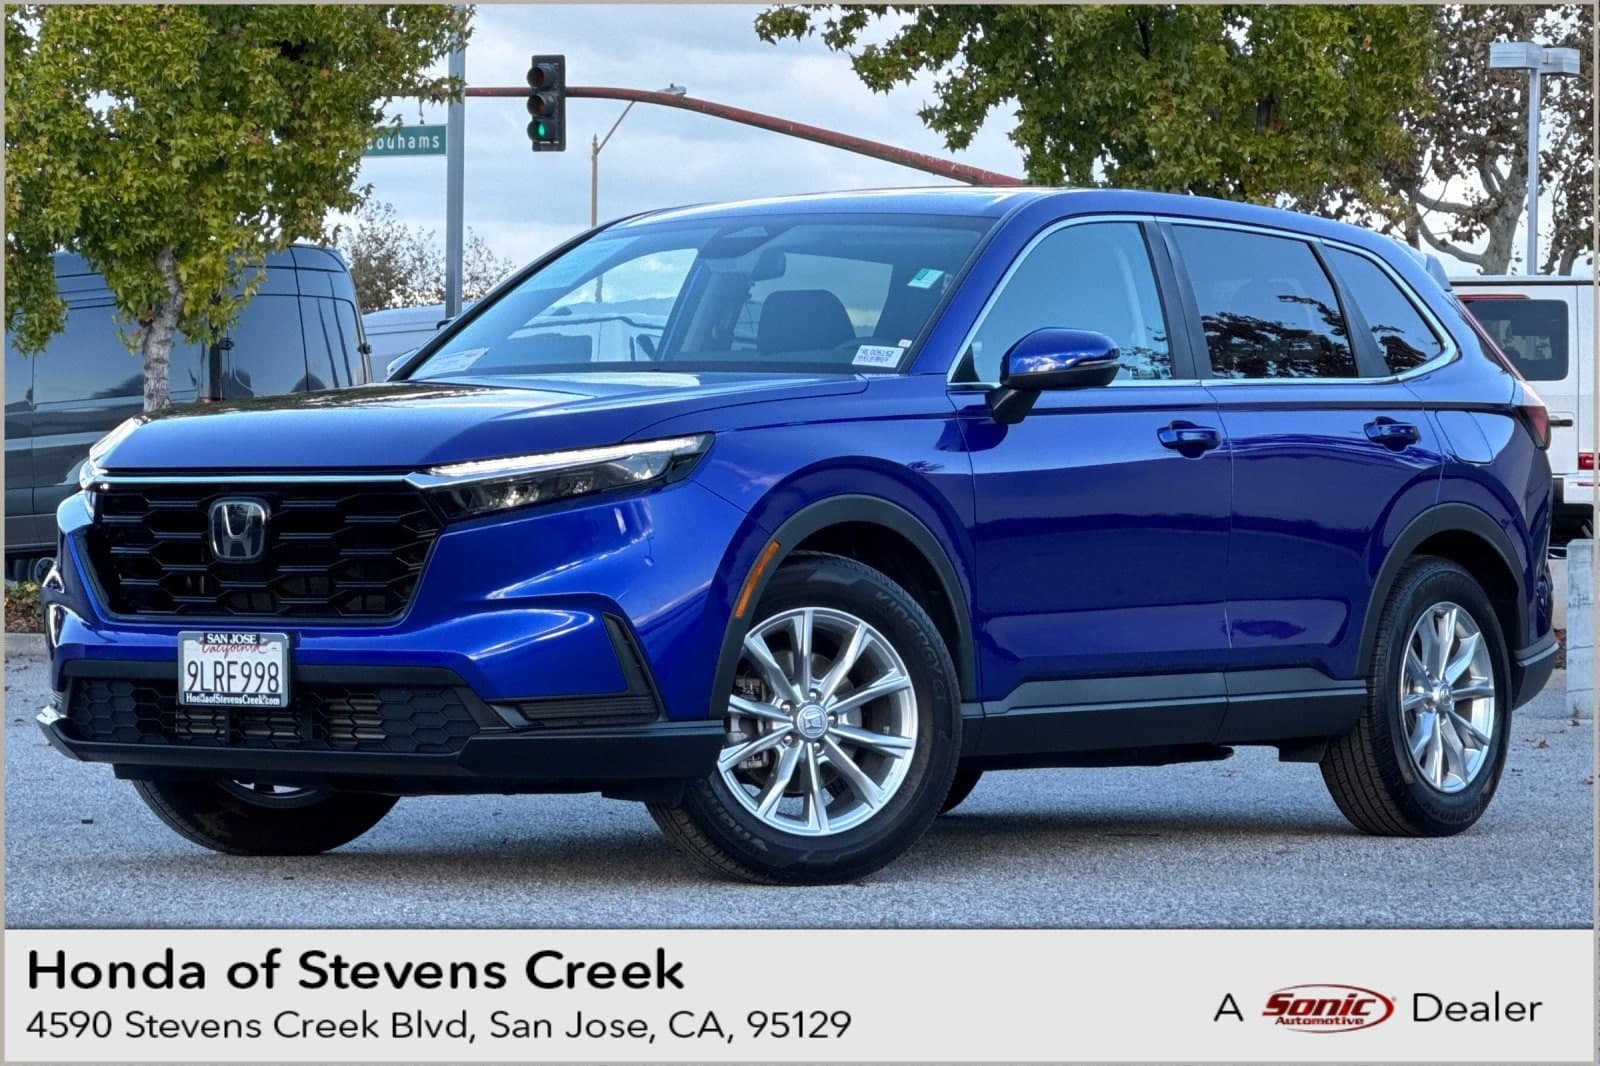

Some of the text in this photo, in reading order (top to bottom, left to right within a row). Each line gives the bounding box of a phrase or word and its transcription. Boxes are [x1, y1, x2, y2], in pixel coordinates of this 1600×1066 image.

[207, 633, 257, 645] SAN JOSE
[187, 660, 280, 693] 9LRF998
